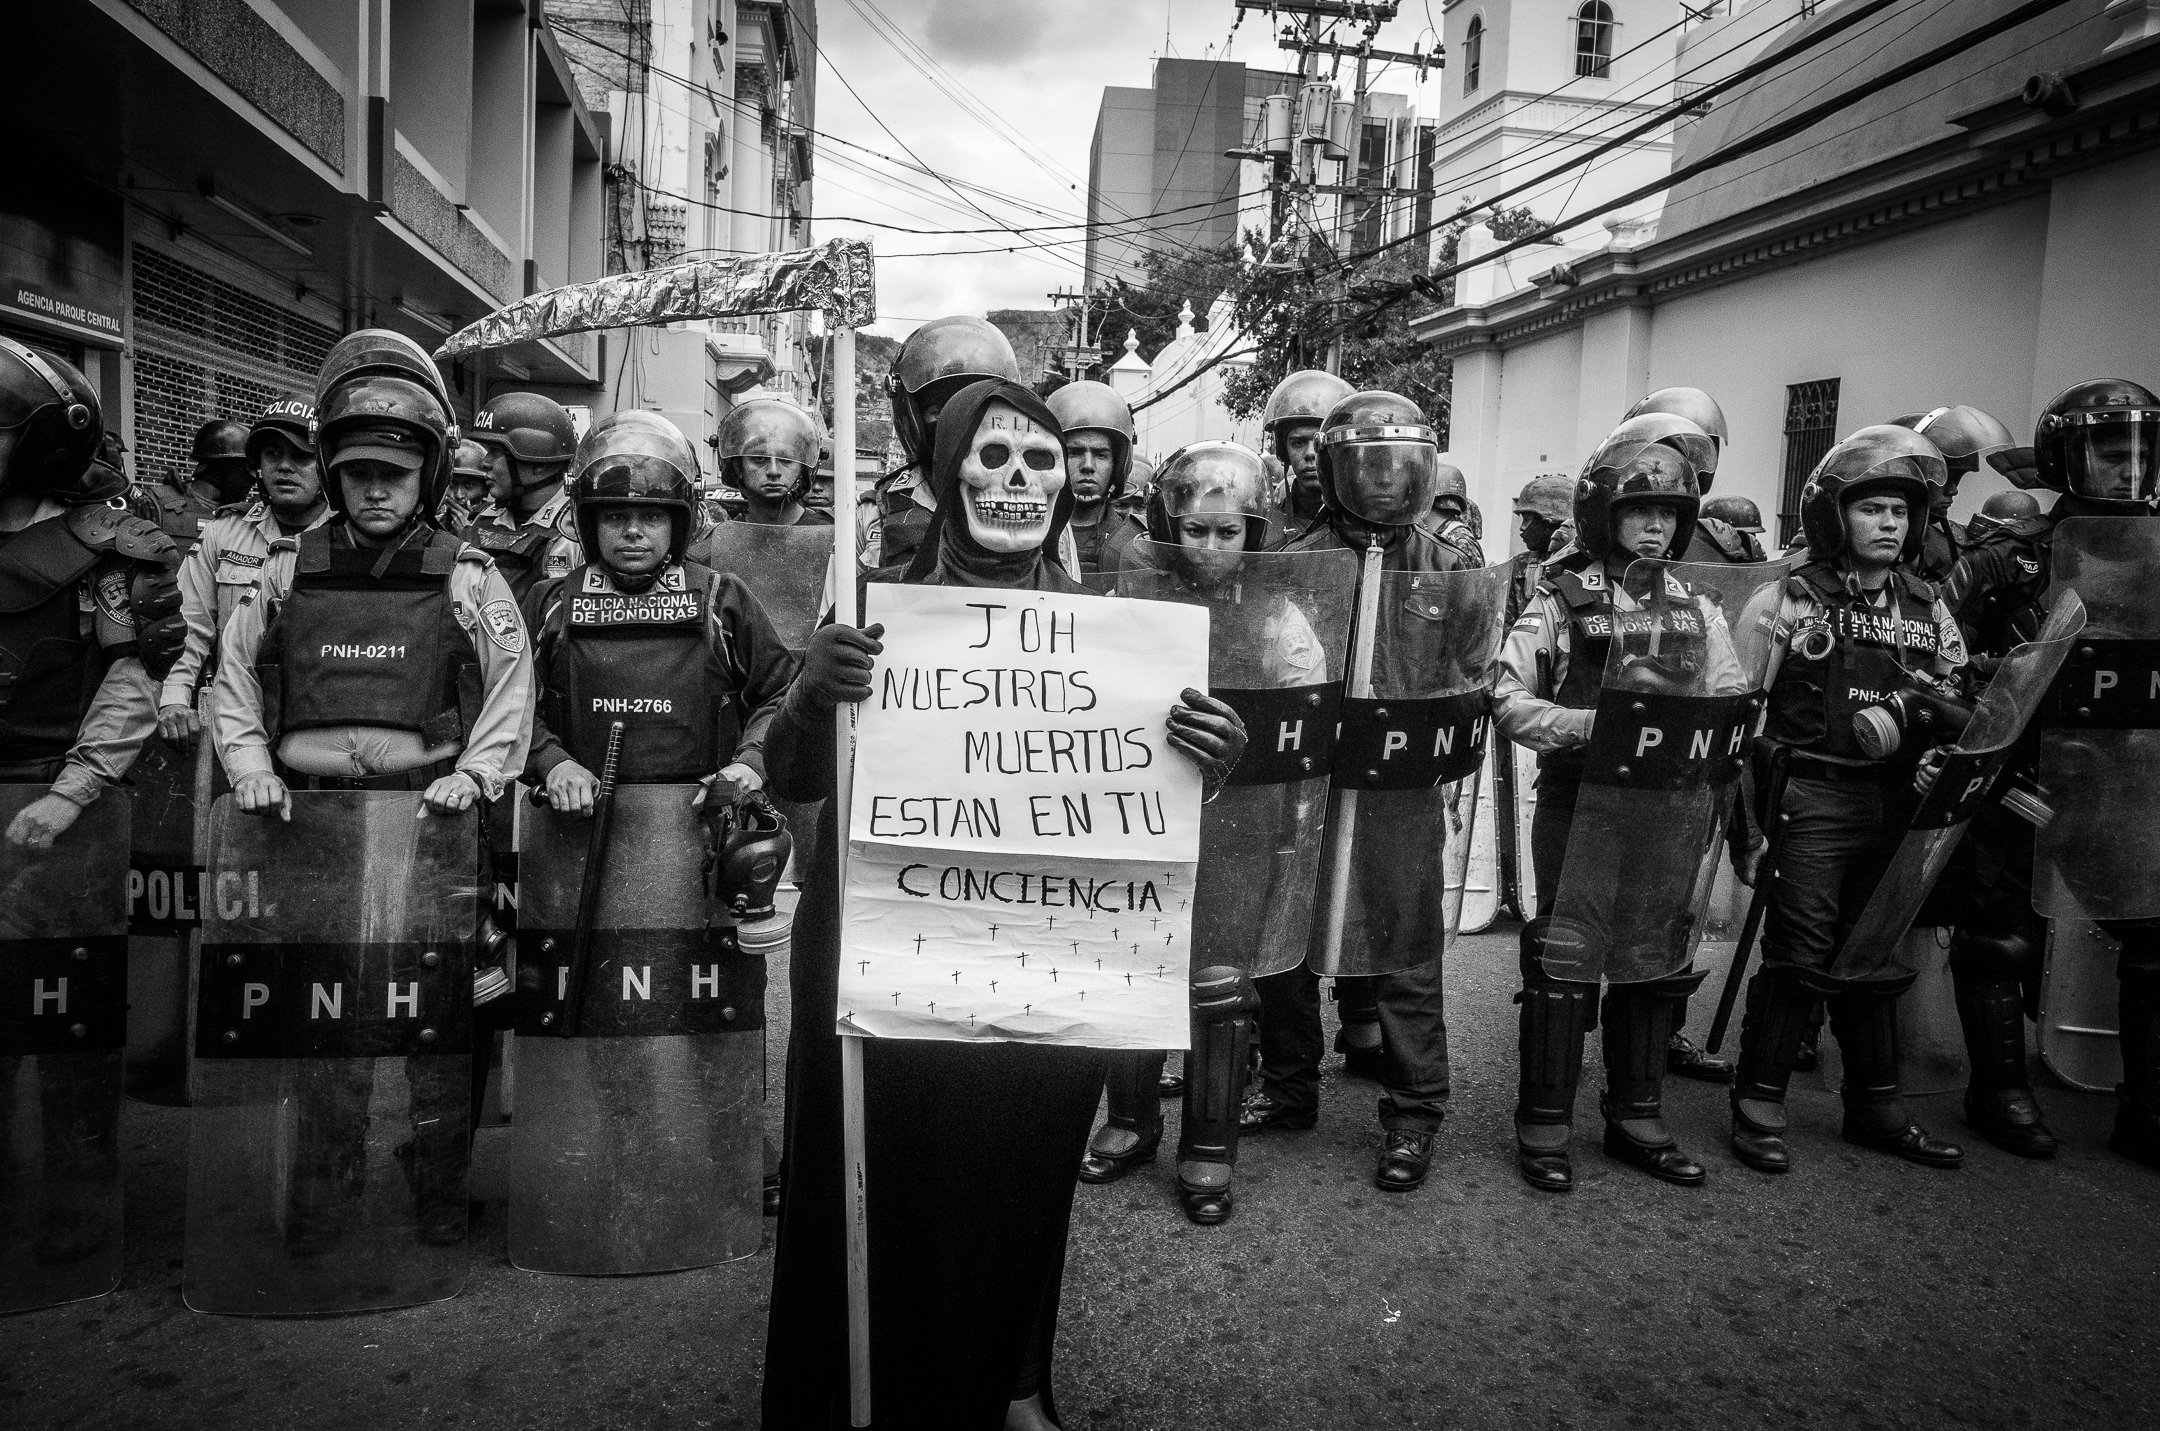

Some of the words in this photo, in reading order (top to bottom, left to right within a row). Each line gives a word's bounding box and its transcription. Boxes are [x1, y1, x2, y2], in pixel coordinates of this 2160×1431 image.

[17, 290, 54, 312] AGENCIA
[55, 301, 86, 322] PARQUE
[87, 311, 120, 332] CENTRAL
[226, 551, 259, 565] AMADOR
[573, 597, 626, 611] POLICIA
[628, 593, 698, 609] NACIONAL
[572, 611, 596, 623] DE
[600, 606, 698, 623] HONDURAS
[1588, 622, 1612, 634] DE
[321, 644, 405, 659] PNH-0211
[881, 667, 1097, 714] NUESTROS
[592, 698, 672, 714] PNH-2766
[965, 728, 1153, 774] MUERTOS
[869, 795, 1001, 838] ESTAN
[1029, 792, 1092, 836] EN
[1104, 791, 1166, 836] TU
[897, 863, 1162, 913] CONCIENCIA
